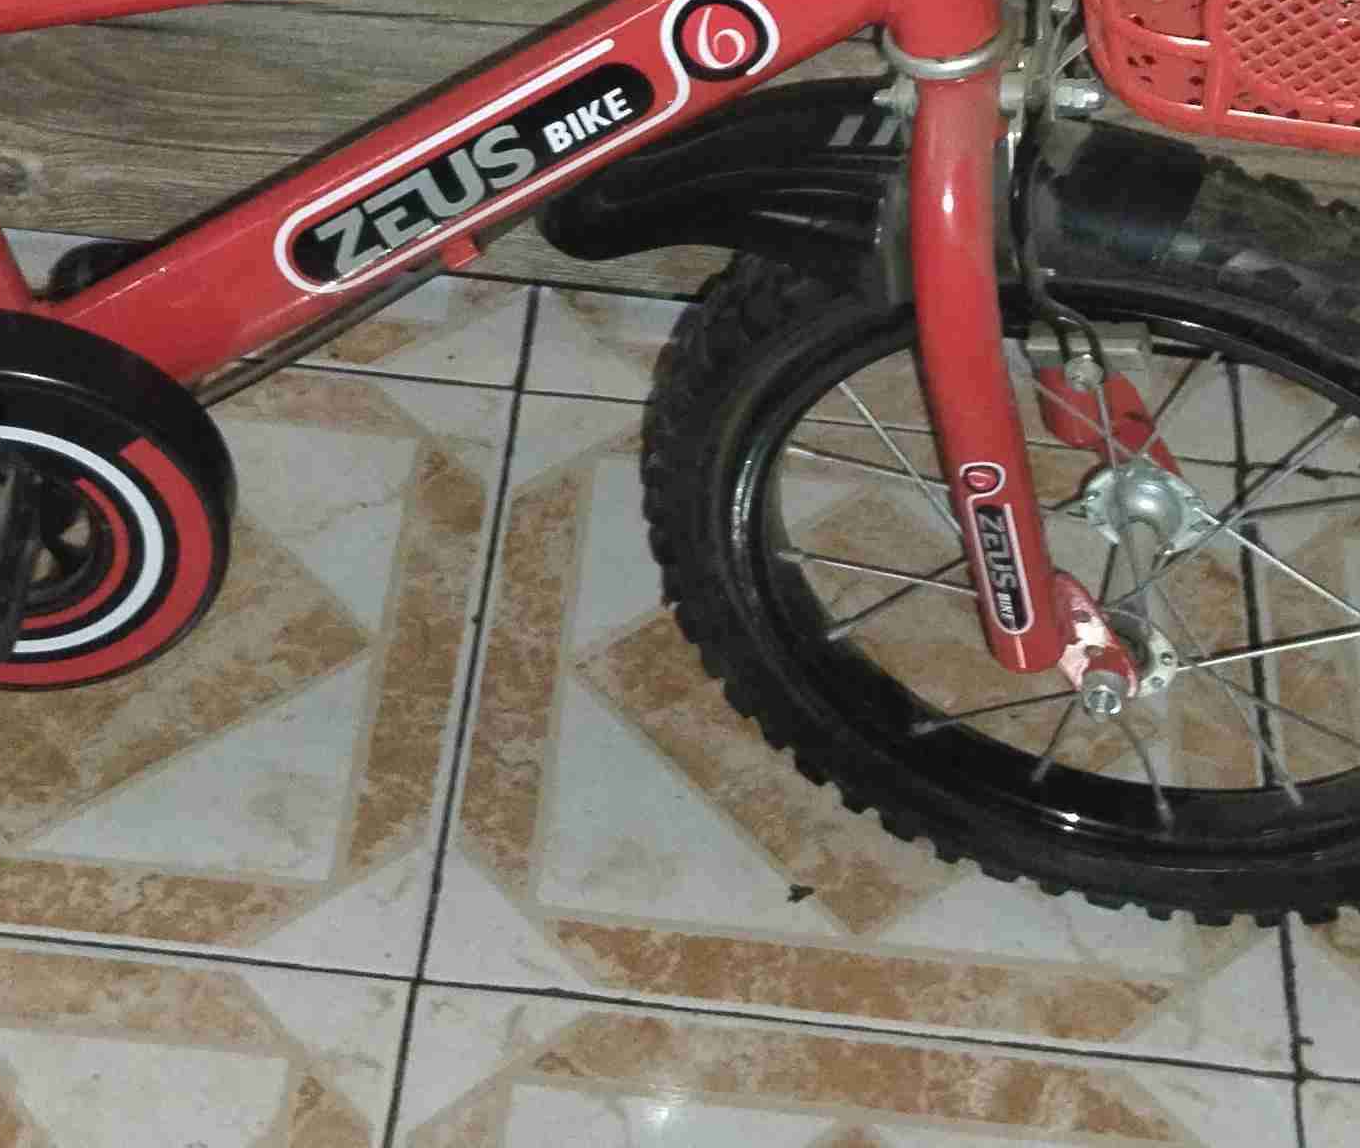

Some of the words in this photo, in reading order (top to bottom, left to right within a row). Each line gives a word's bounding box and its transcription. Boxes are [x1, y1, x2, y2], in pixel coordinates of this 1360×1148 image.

[314, 123, 537, 279] ZEUS
[542, 86, 634, 154] BIKE
[976, 512, 1018, 590] ZEUS
